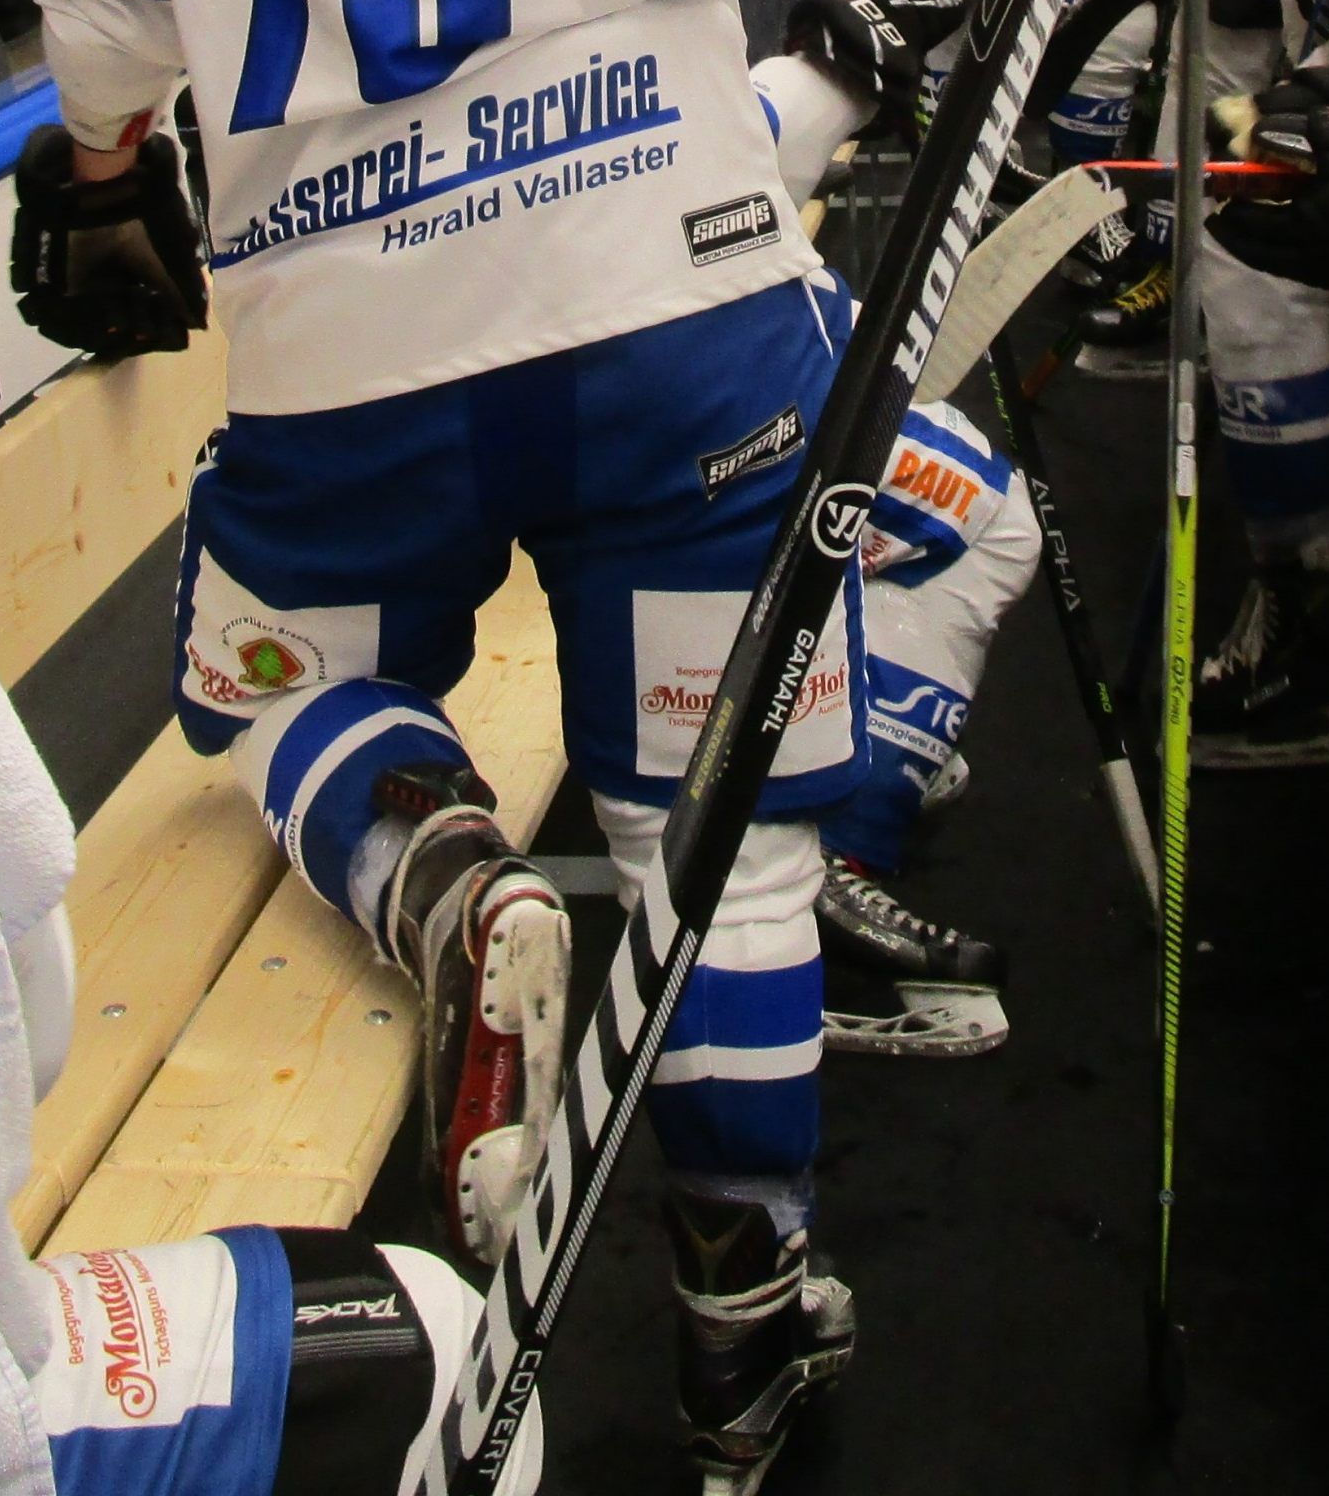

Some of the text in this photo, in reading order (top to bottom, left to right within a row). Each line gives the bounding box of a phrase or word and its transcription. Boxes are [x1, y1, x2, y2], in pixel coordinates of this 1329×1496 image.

[466, 52, 661, 171] Service
[381, 138, 681, 255] Harald Vallaster
[692, 198, 772, 247] scoots
[890, 448, 981, 526] BAUT.
[1032, 476, 1083, 614] ALPHA
[762, 627, 816, 733] GANAHL
[145, 1288, 172, 1368] Tschagguns
[294, 1292, 401, 1324] TACKS
[475, 1348, 545, 1482] COVERT
